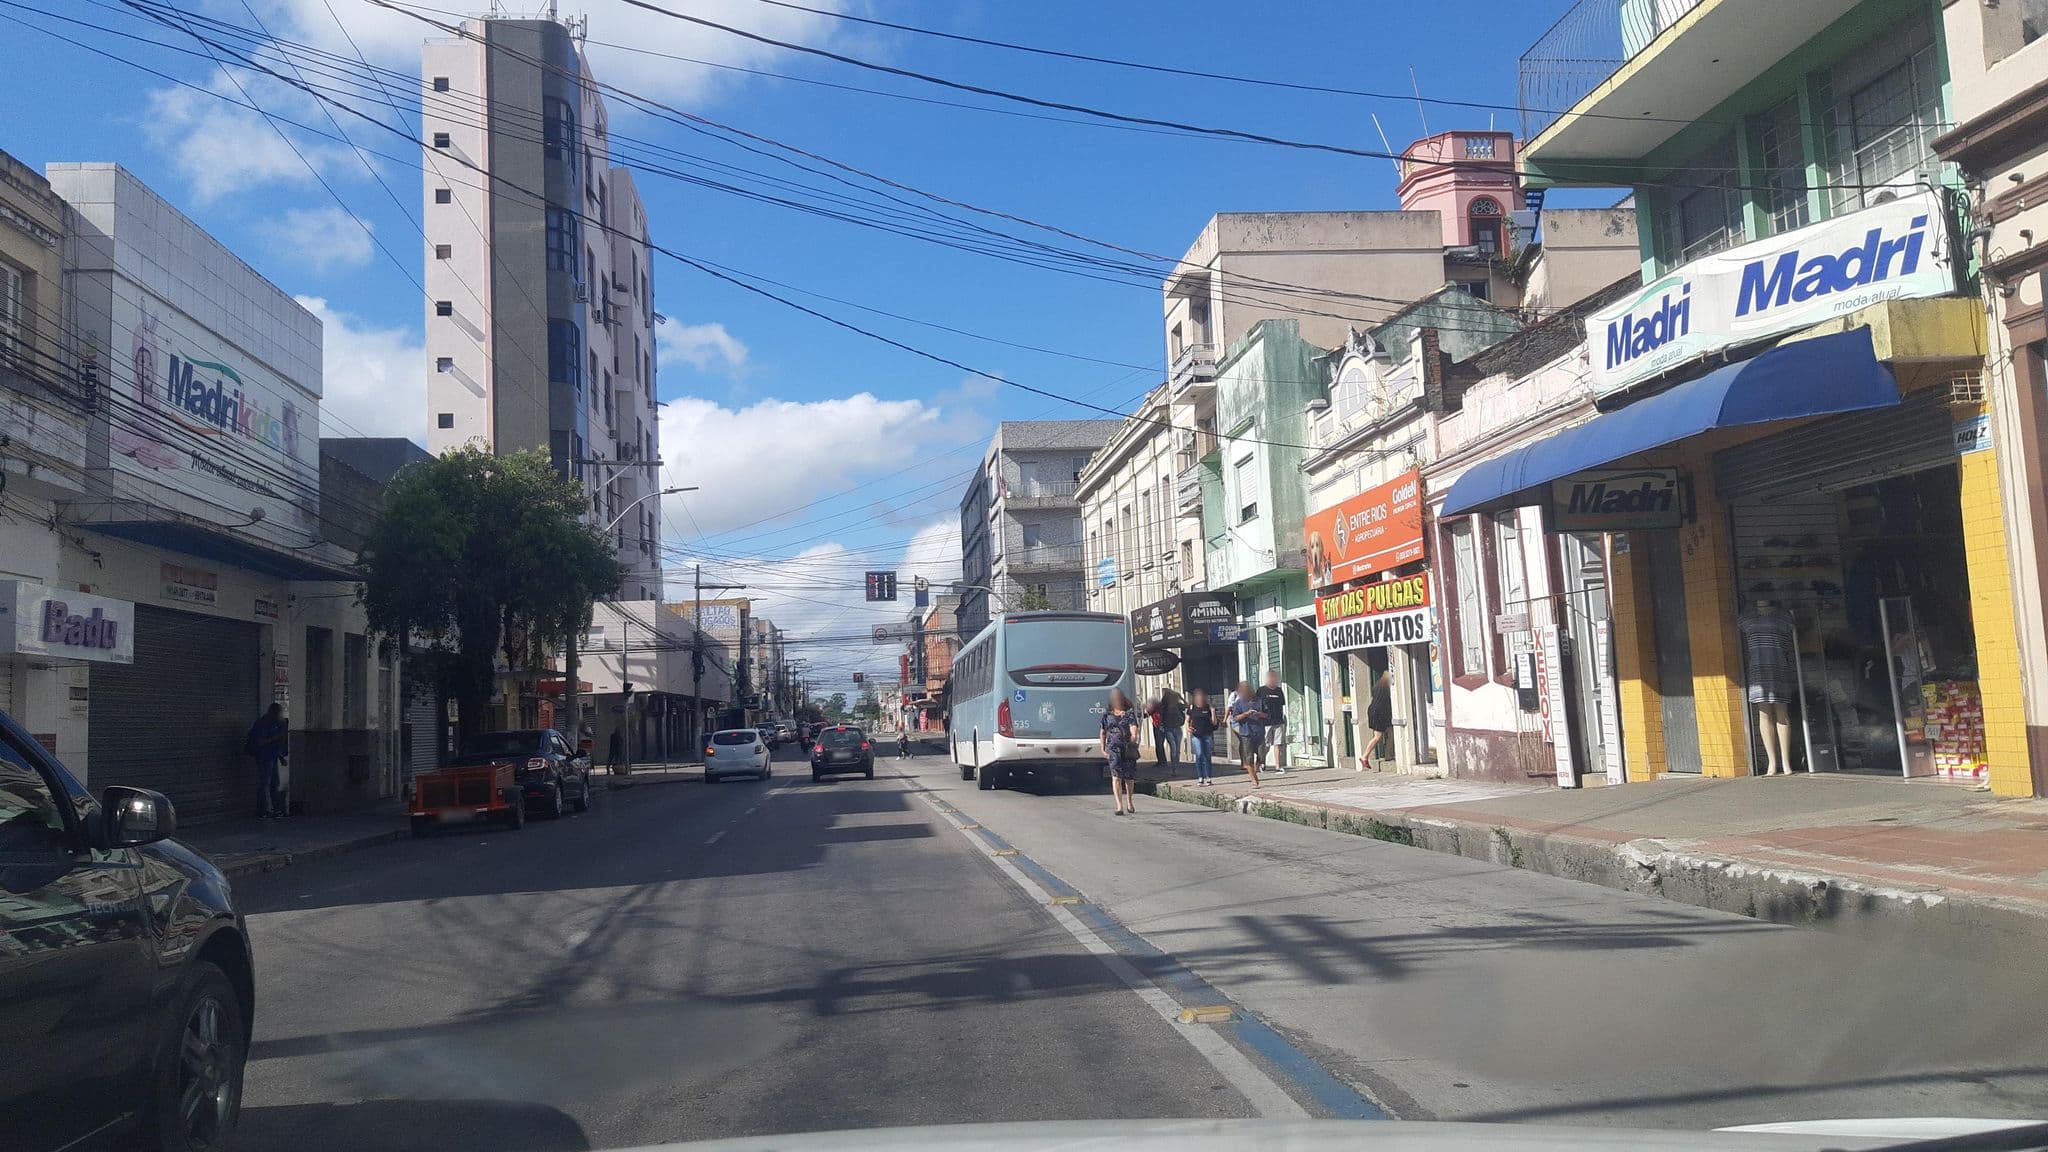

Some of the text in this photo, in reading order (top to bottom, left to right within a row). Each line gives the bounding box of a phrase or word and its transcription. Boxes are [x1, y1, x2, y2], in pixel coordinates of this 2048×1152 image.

[1735, 213, 1928, 317] Madri
[1833, 295, 1868, 312] moda
[1606, 282, 1691, 370] Madri
[1957, 427, 1987, 443] HOLZ
[1568, 480, 1675, 514] Madri
[1350, 502, 1387, 532] ENTRE RIOS
[1190, 606, 1231, 617] AMINNA
[1341, 589, 1364, 617] DAS
[1366, 577, 1424, 613] PULGAS
[42, 600, 117, 649] Badu
[1331, 613, 1424, 650] CARRAPATOS
[1534, 629, 1554, 743] XEROX
[1014, 720, 1030, 728] 535
